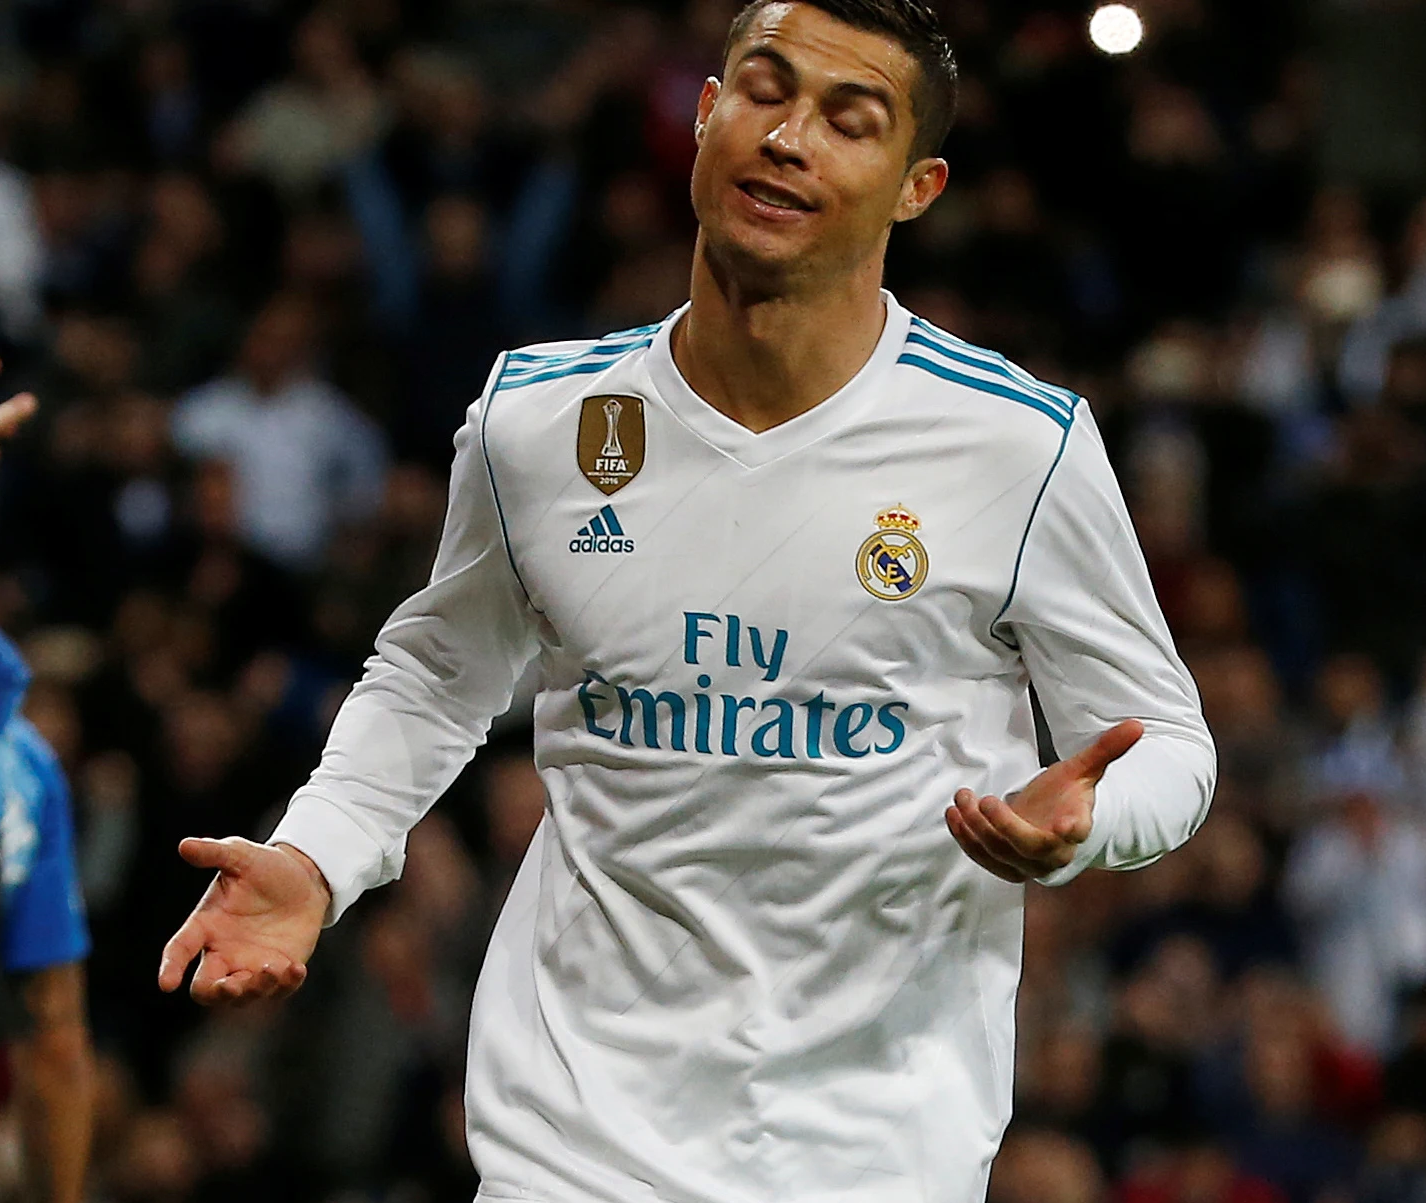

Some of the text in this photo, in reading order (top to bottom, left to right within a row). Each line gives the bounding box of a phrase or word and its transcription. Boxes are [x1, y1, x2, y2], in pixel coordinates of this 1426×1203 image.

[595, 458, 627, 471] FIFA
[599, 476, 619, 485] 2016
[570, 535, 634, 553] adidas
[682, 611, 788, 682] Fly
[577, 668, 909, 759] Emirates
